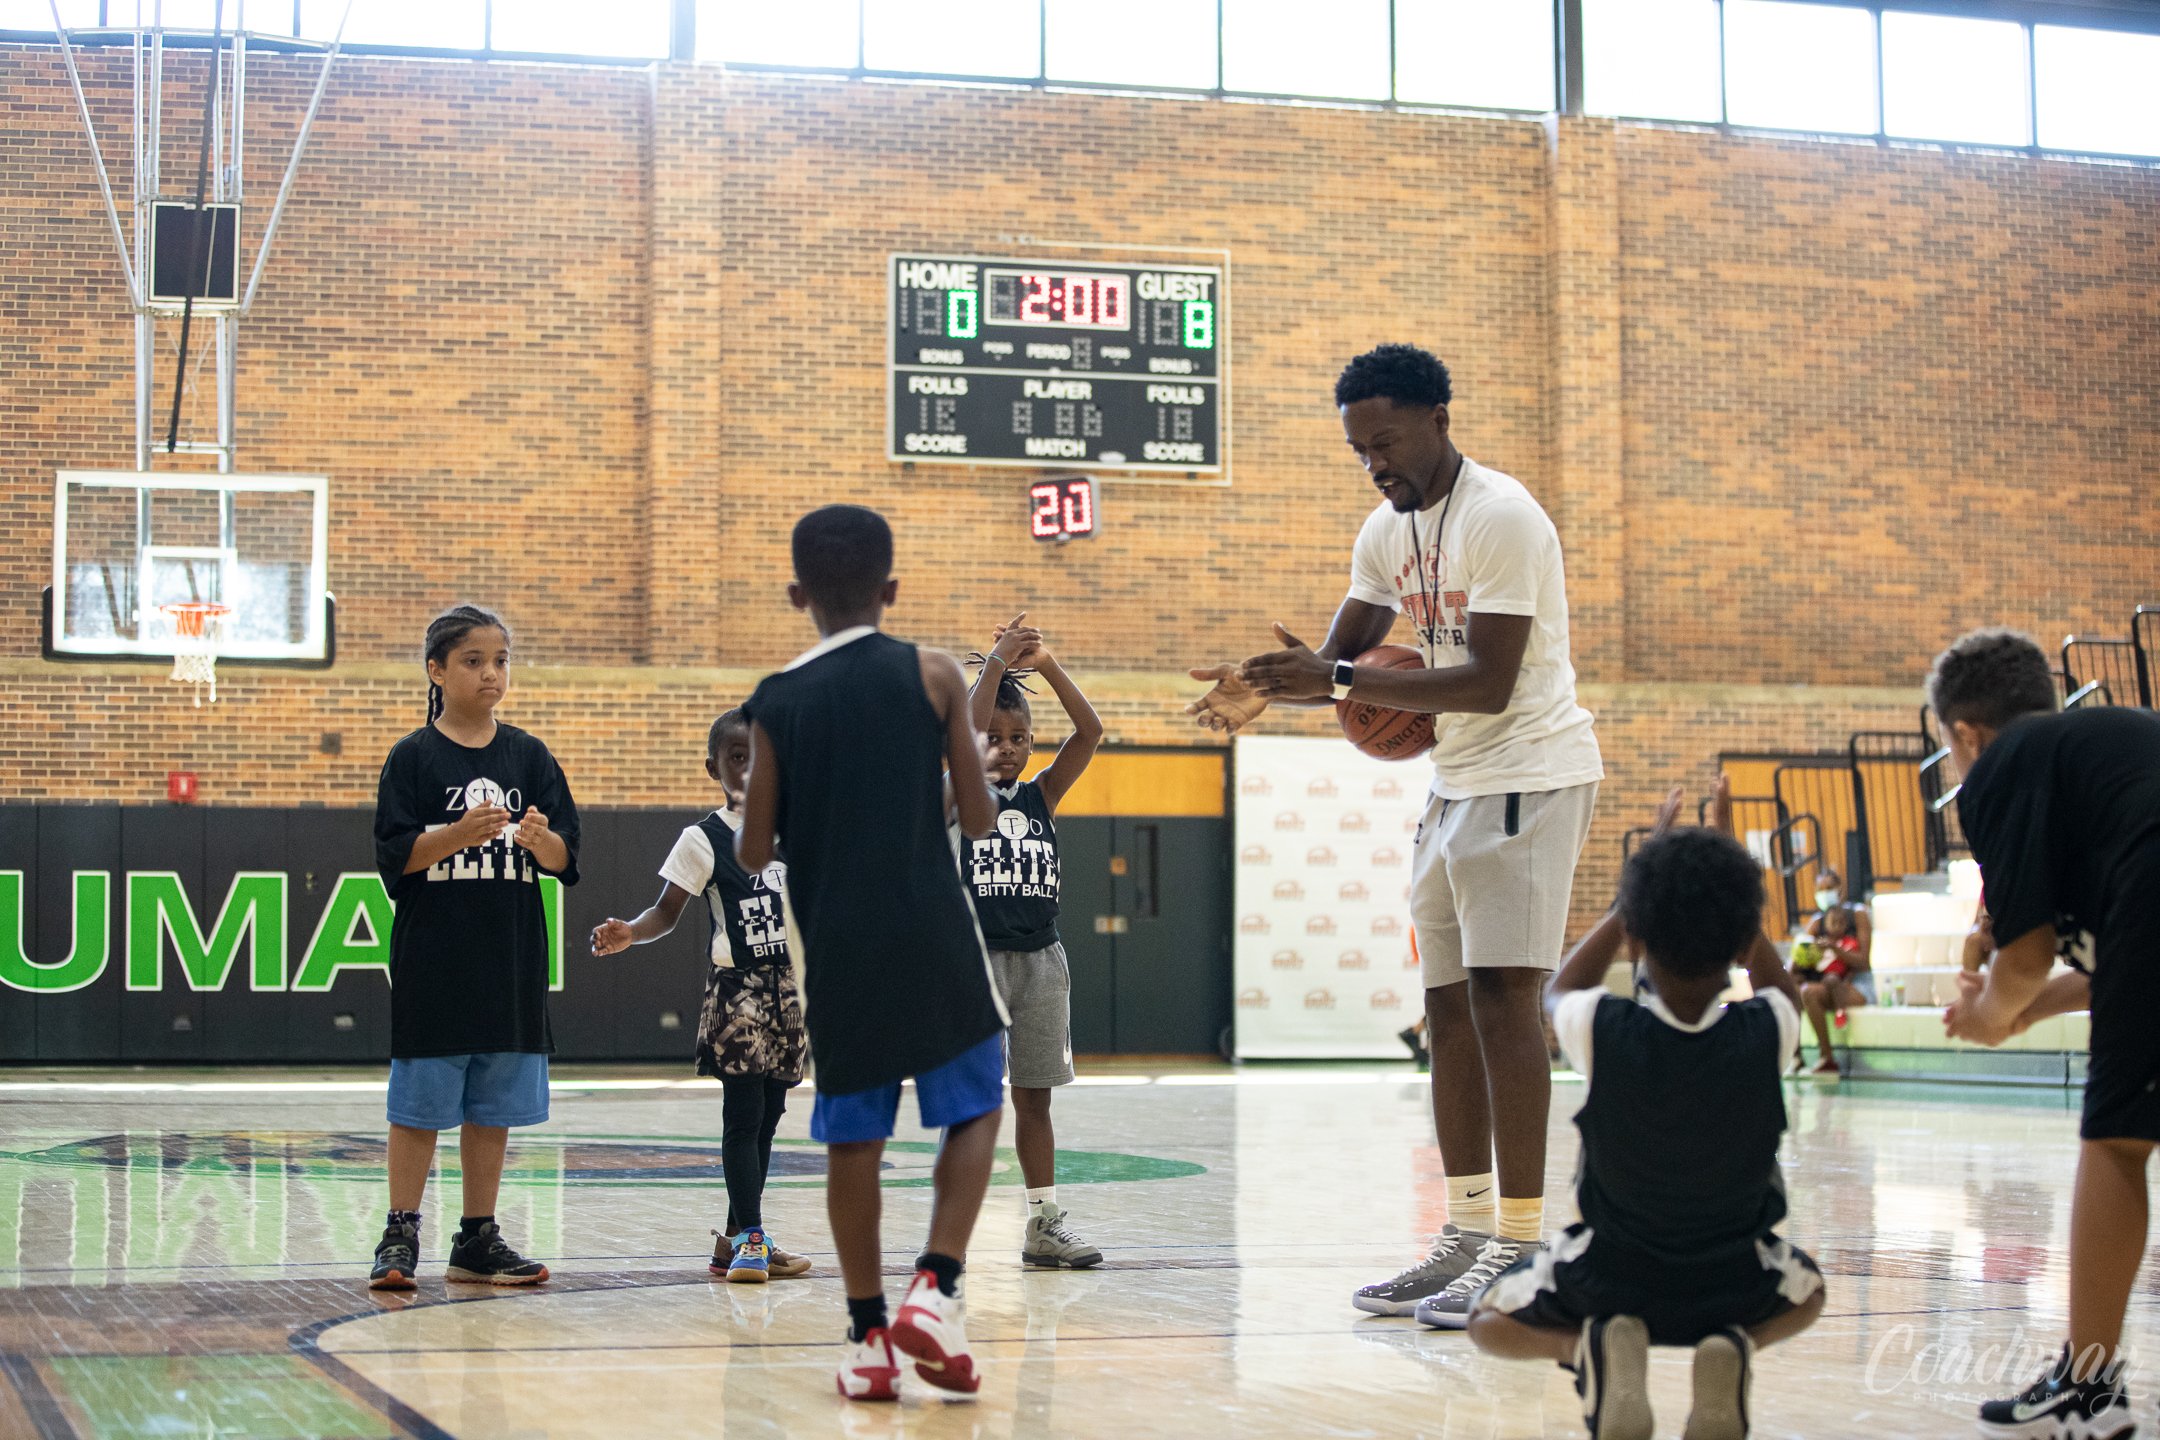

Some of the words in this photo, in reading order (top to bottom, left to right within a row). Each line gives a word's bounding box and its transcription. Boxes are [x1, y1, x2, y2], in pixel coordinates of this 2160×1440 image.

[900, 262, 978, 290] HOME
[1136, 272, 1214, 302] GUEST
[1021, 275, 1125, 326] 2:00
[948, 290, 978, 338] 0
[1184, 300, 1213, 350] 8
[919, 348, 964, 364] BONUS
[1026, 343, 1071, 360] PERIOD
[1149, 357, 1192, 374] BONUS
[908, 376, 968, 395] FOULS
[1024, 379, 1092, 400] PLAYER
[1147, 384, 1205, 405] FOULS
[904, 434, 967, 454] SCORE
[1025, 438, 1086, 458] MATCH
[1143, 442, 1205, 463] SCORE
[1030, 482, 1093, 536] 20
[972, 838, 1056, 886] ELITE
[978, 884, 1018, 897] BITTY
[1022, 884, 1053, 898] BALL
